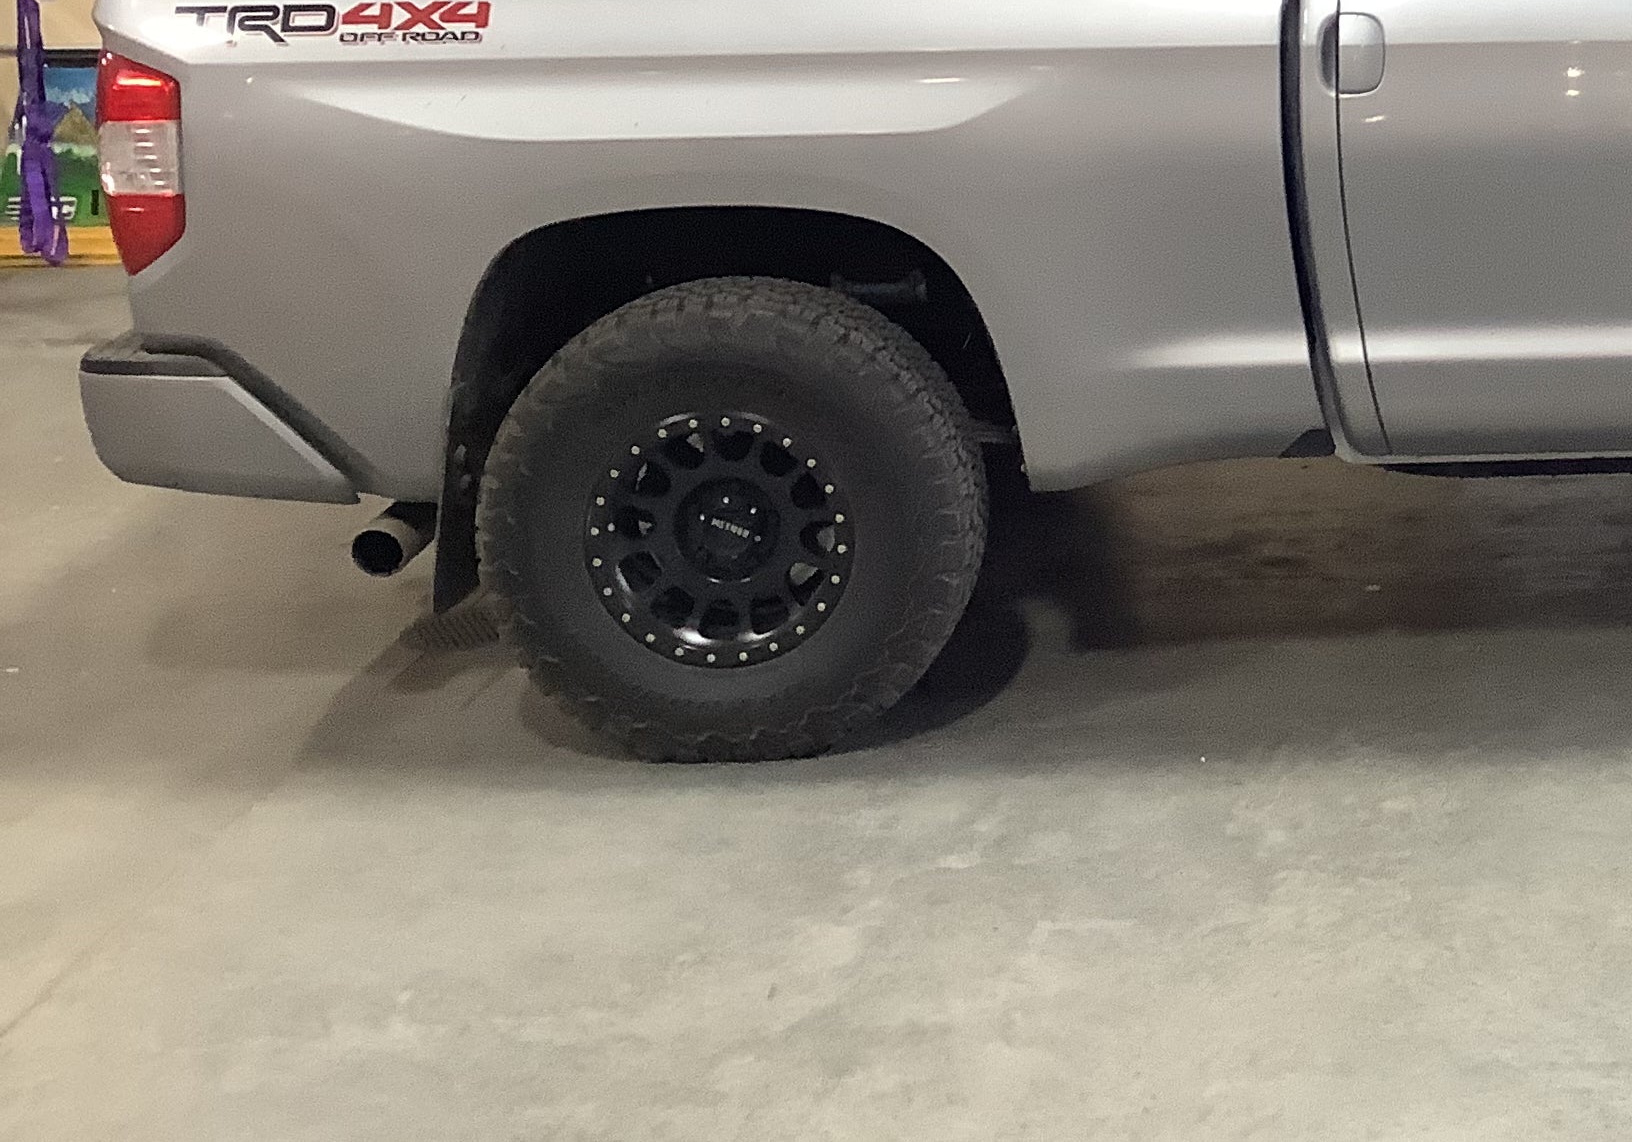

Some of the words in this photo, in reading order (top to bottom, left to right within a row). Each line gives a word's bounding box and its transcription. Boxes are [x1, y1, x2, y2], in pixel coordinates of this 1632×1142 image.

[175, 4, 339, 45] TRD
[341, 0, 491, 30] 4X4
[339, 31, 397, 45] OFF
[401, 30, 482, 45] ROAD
